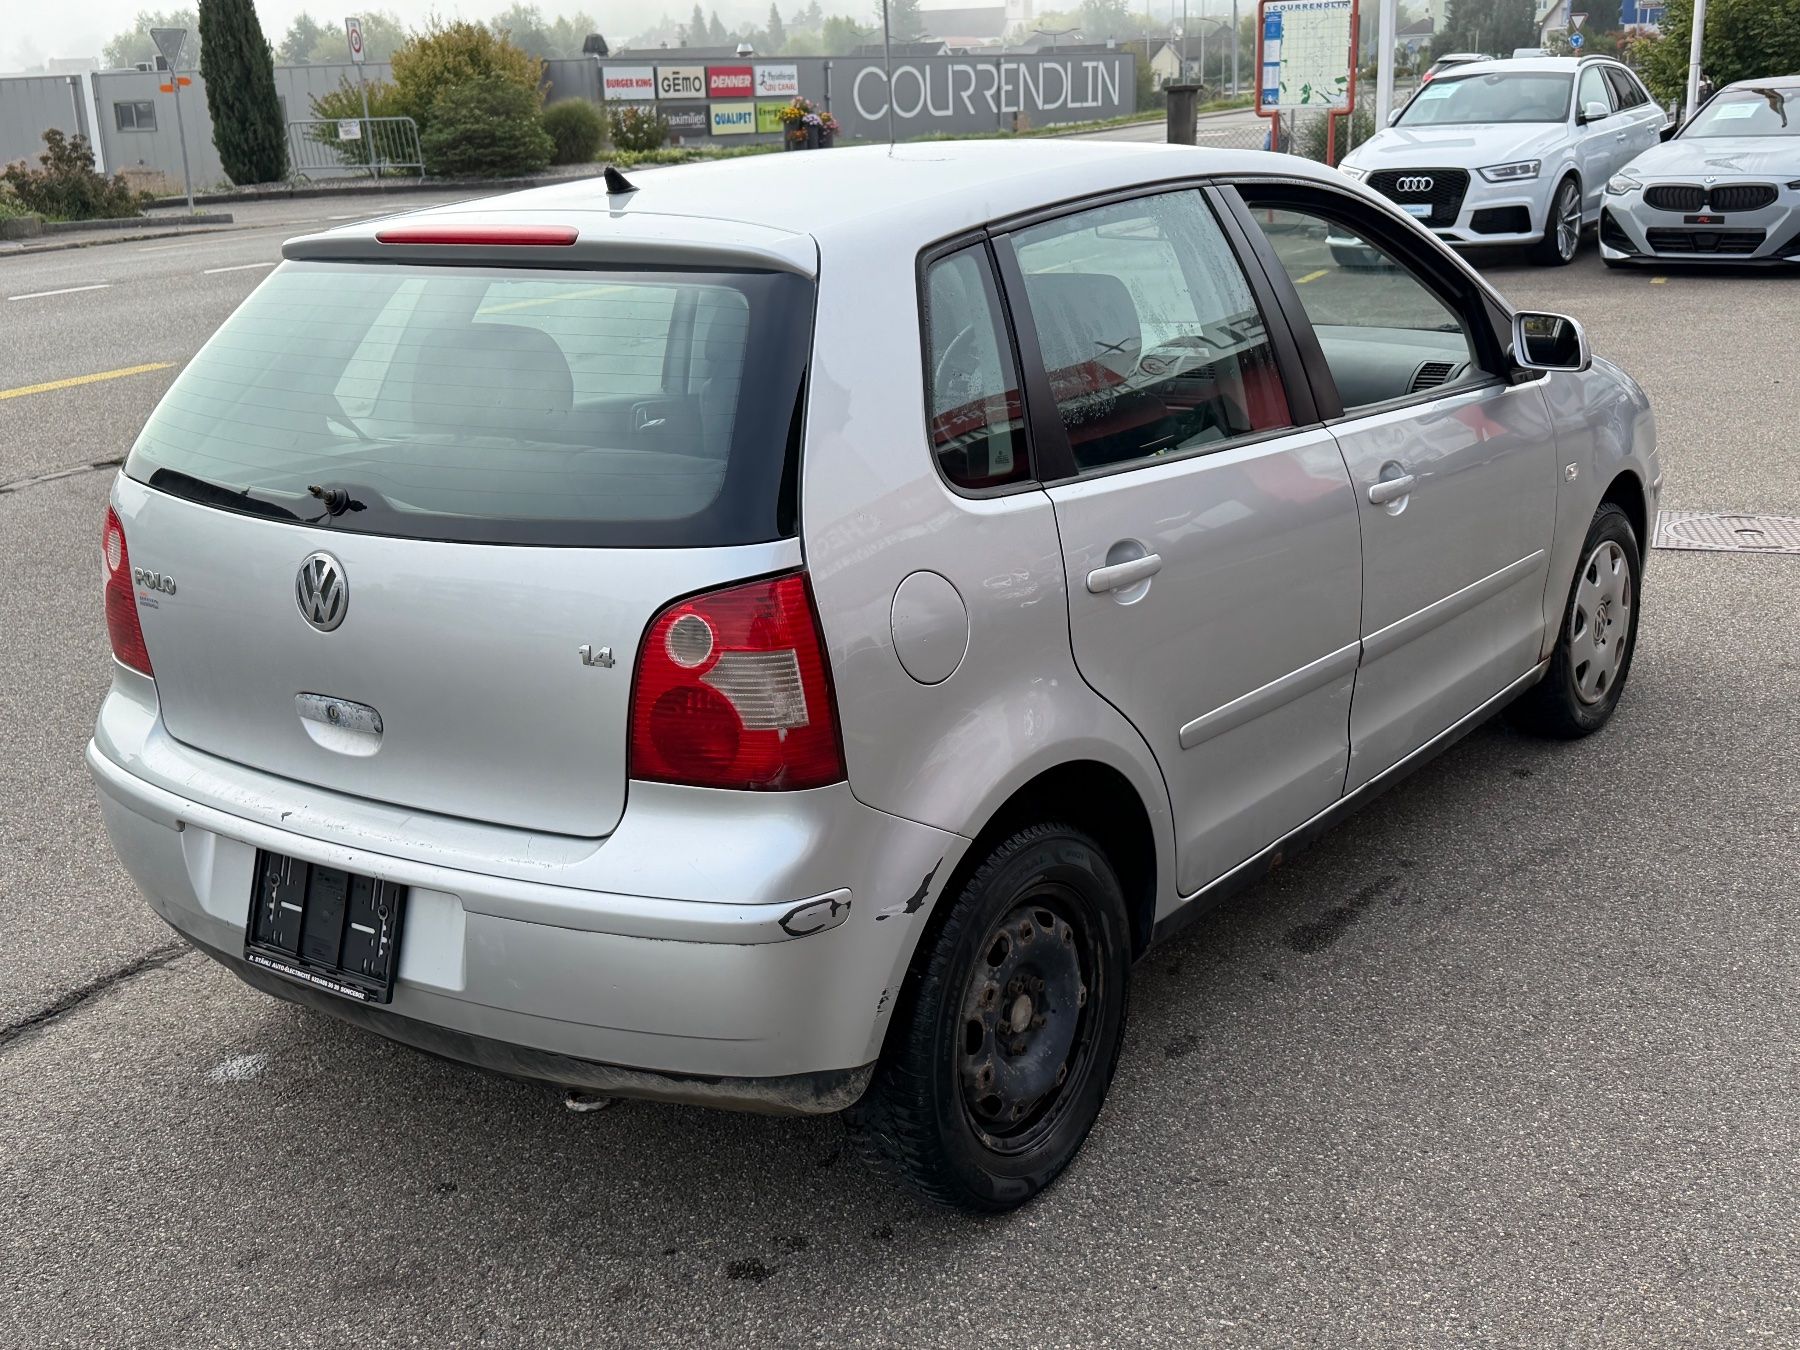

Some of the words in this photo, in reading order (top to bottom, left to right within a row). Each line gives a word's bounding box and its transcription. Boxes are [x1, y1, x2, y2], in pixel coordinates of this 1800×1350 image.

[606, 78, 634, 89] BURGER
[635, 78, 653, 88] KING
[711, 75, 751, 89] DENNER
[853, 60, 1119, 120] COURRENDLIN
[714, 112, 753, 126] QUALIPET
[135, 566, 177, 596] POLO
